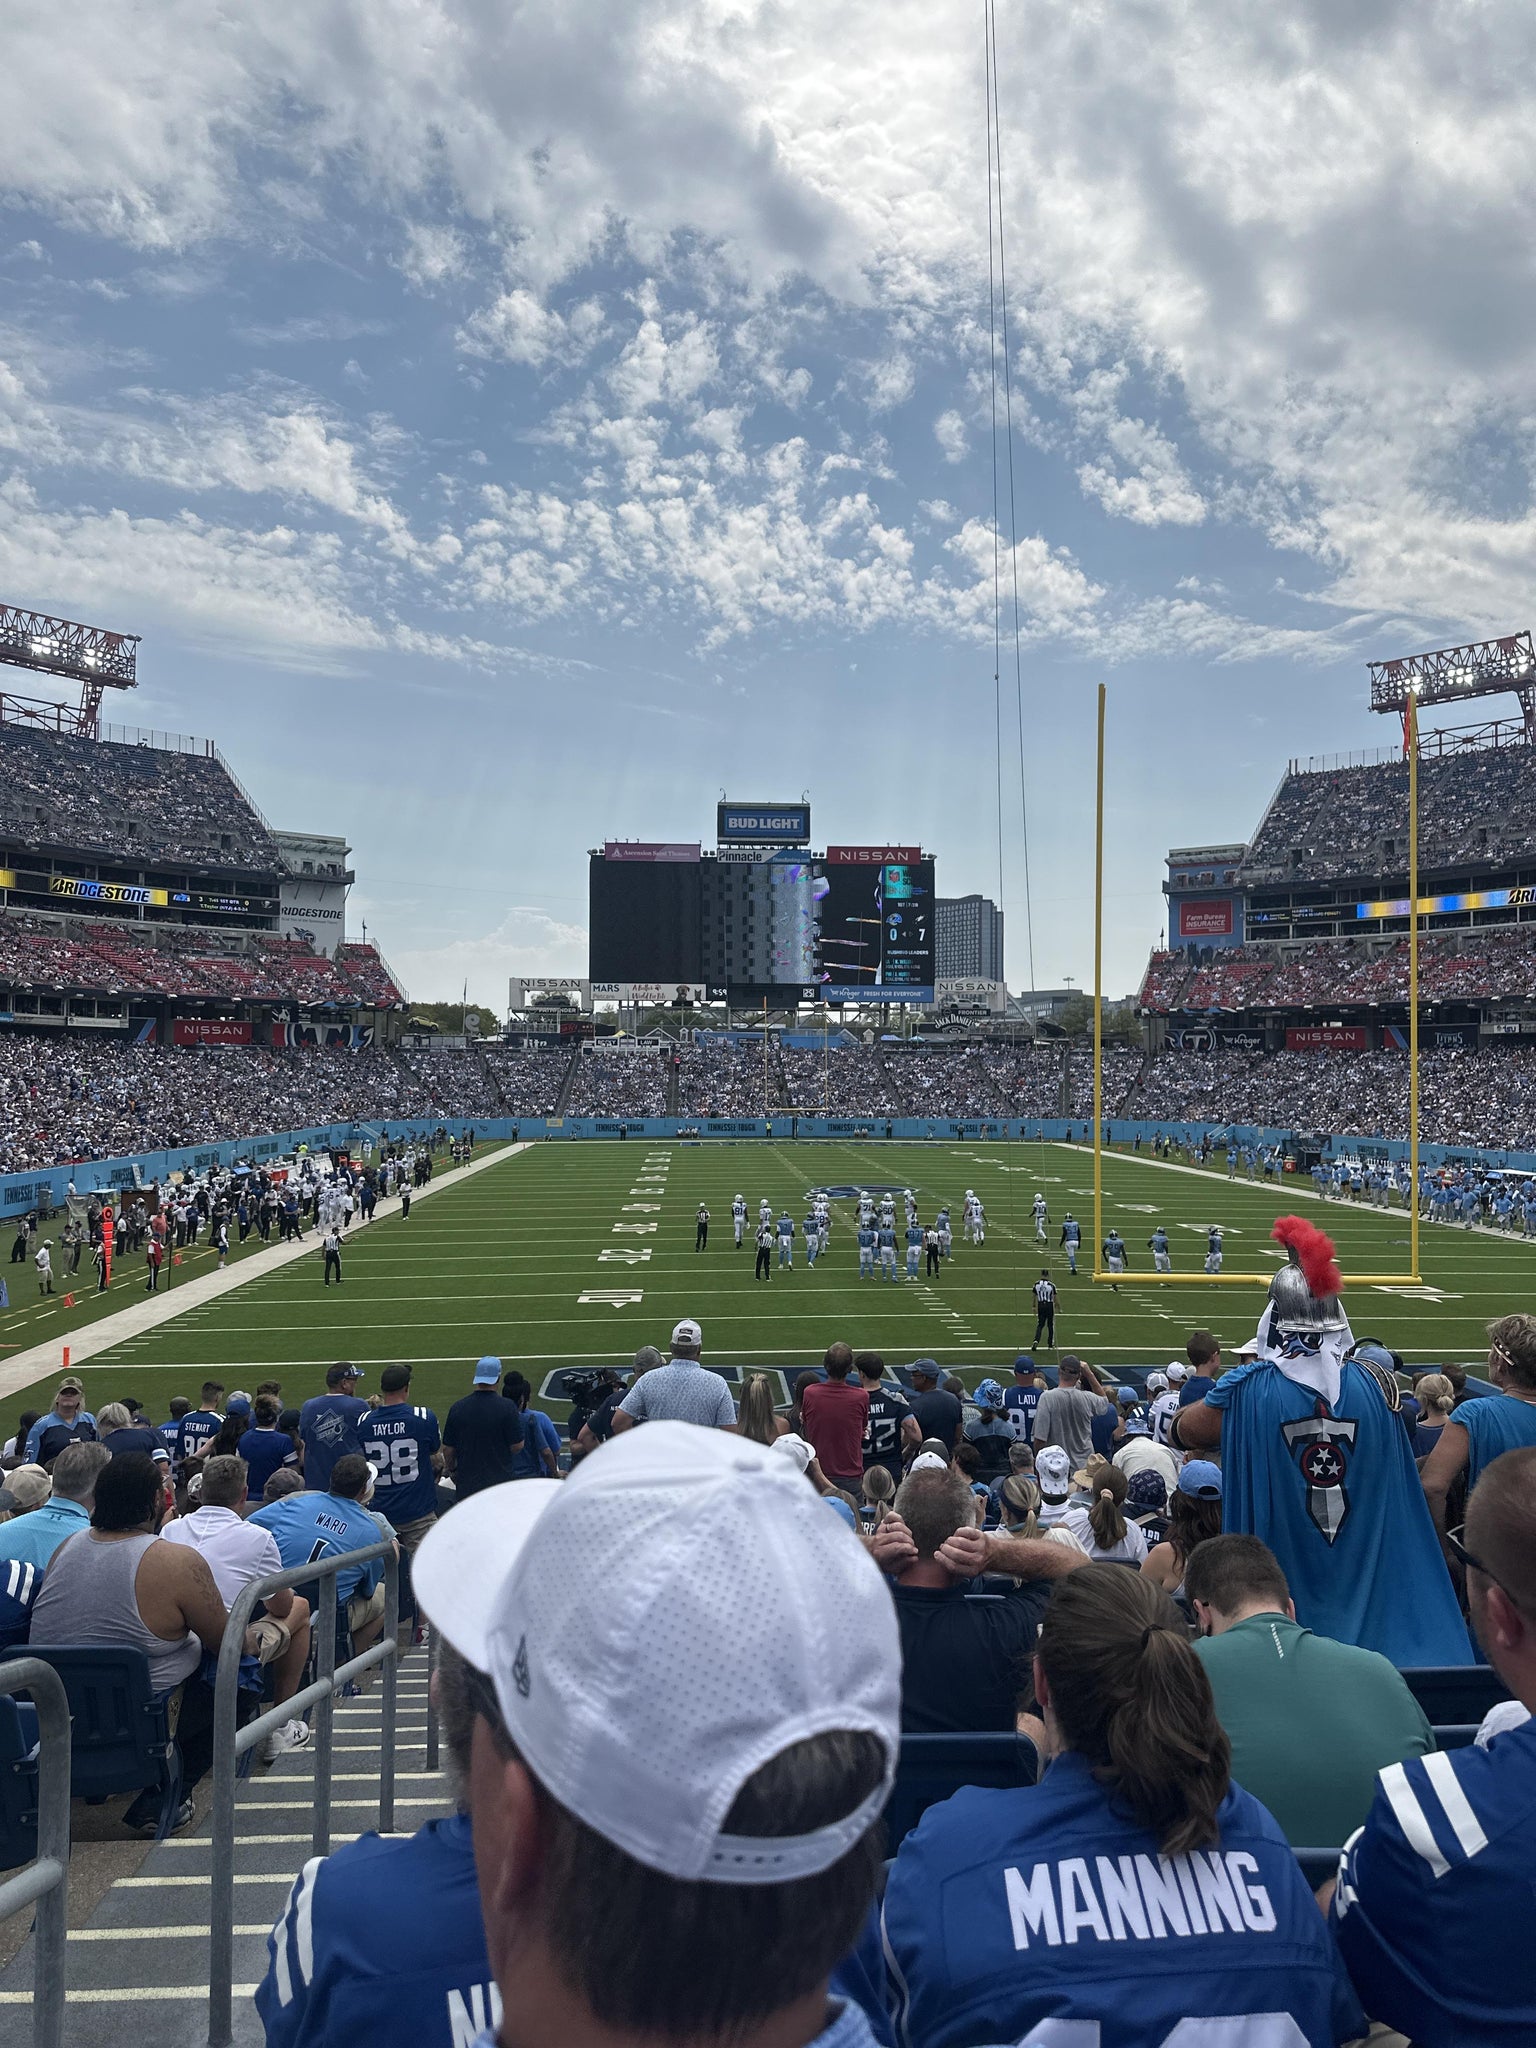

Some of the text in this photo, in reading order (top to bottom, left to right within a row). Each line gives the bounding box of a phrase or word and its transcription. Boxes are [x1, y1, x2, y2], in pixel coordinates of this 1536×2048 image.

[728, 818, 799, 829] BUD LIGHT
[719, 851, 762, 862] Pinnacle
[840, 852, 909, 861] NISSAN
[51, 878, 150, 903] BRIDGESTONE
[1508, 889, 1536, 904] BRI
[1186, 920, 1226, 928] INSURANCE
[890, 928, 926, 941] 0 7
[592, 984, 620, 992] MARS
[712, 988, 728, 996] 9:59
[939, 983, 997, 991] NISSAN
[839, 987, 861, 1000] Kroger
[934, 1016, 950, 1029] JACK
[184, 1024, 243, 1036] NISSAN
[1234, 1034, 1261, 1048] Kroger
[1296, 1031, 1355, 1041] NISSAN
[707, 1122, 756, 1132] TENNESSEE TOUGH
[1018, 1394, 1036, 1405] LATU
[184, 1422, 211, 1433] STEWART
[372, 1422, 406, 1436] TAYLOR
[364, 1438, 420, 1486] 28
[315, 1511, 349, 1536] WARD
[1004, 1851, 1278, 1951] MANNING
